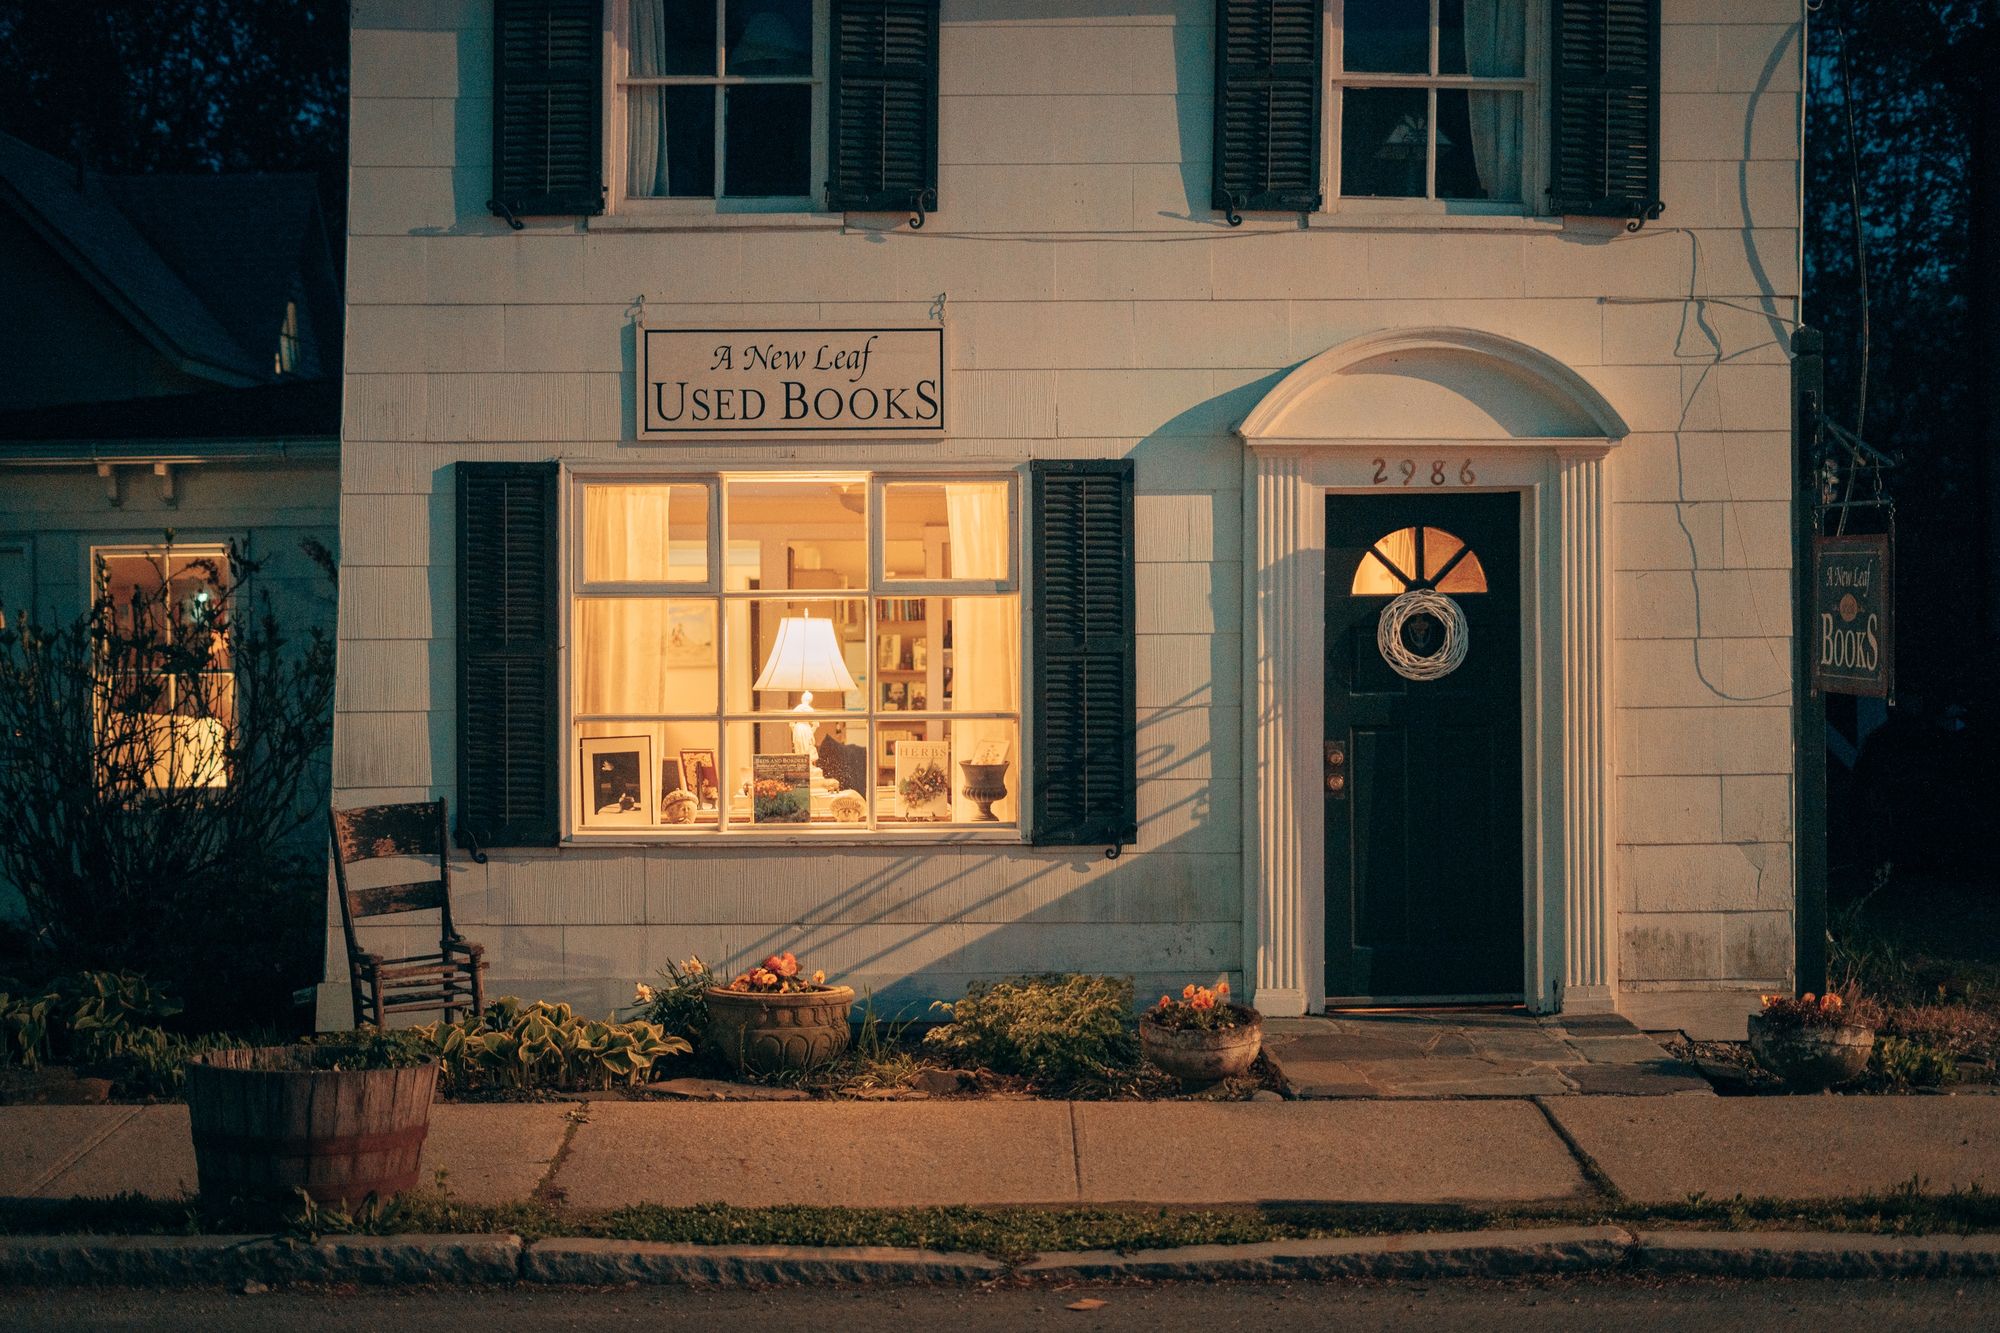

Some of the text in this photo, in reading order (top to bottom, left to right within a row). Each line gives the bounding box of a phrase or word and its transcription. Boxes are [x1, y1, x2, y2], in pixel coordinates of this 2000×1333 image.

[710, 335, 878, 382] A New Leaf
[1372, 457, 1475, 486] 2986
[1826, 559, 1873, 597] A New Leaf
[900, 748, 946, 757] HERBS
